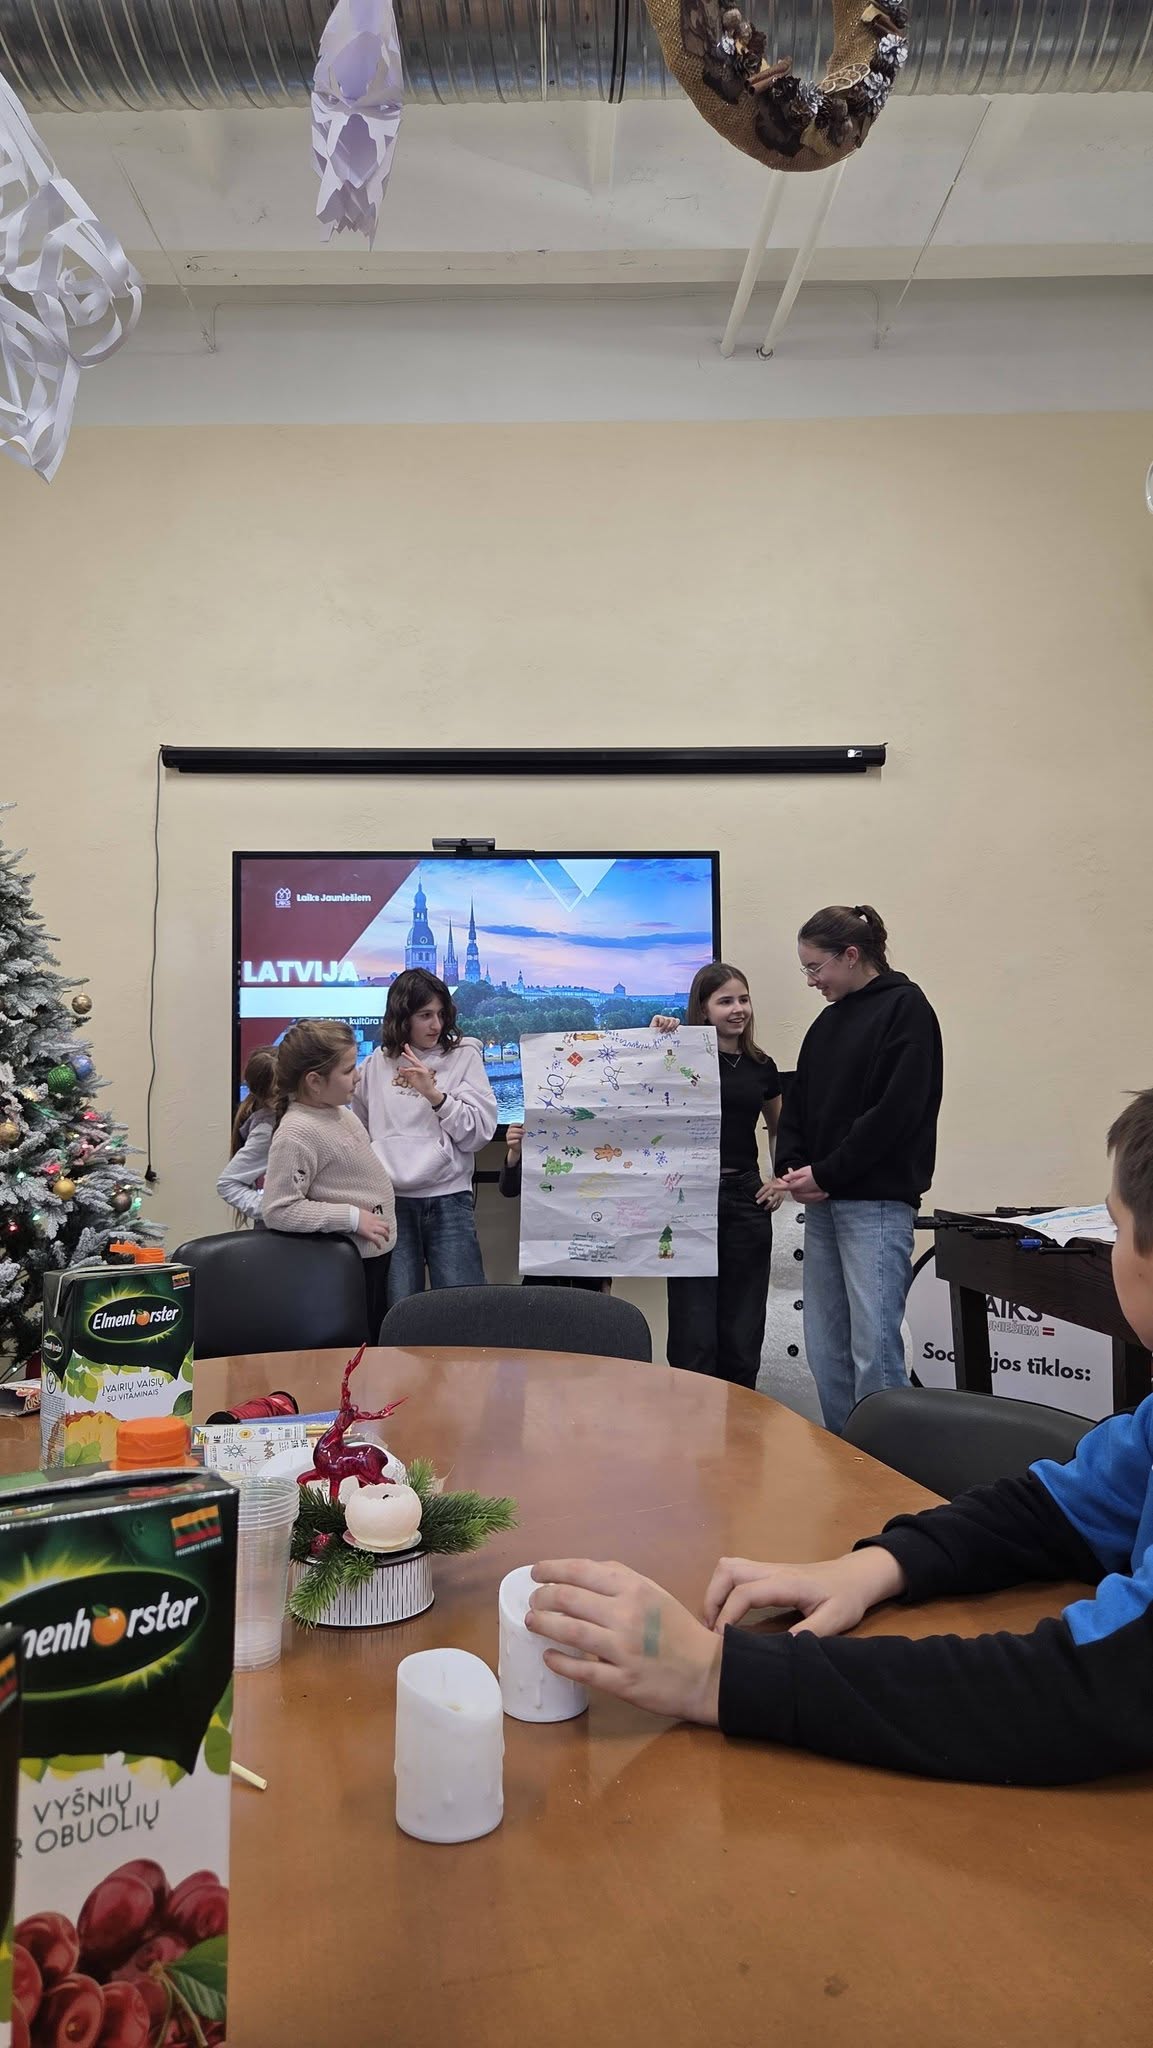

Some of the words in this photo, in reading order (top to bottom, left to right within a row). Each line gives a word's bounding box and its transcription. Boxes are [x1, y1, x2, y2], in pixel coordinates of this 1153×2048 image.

[296, 893, 320, 902] Laiks
[243, 960, 359, 982] LATVIJA
[349, 1017, 380, 1026] kultūra
[92, 1305, 179, 1330] Elmenhorster
[986, 1295, 1043, 1323] AIKS
[989, 1319, 1040, 1337] NIEŠIEM
[1027, 1356, 1091, 1381] tīklos:
[102, 1382, 134, 1397] ĮVAIRIŲ
[136, 1377, 165, 1391] VAISIŲ
[107, 1395, 117, 1403] SU
[119, 1388, 160, 1401] VITAMINAIS
[33, 1780, 132, 1825] VYŠNIŲ
[35, 1799, 160, 1854] OBUOLIŲ
